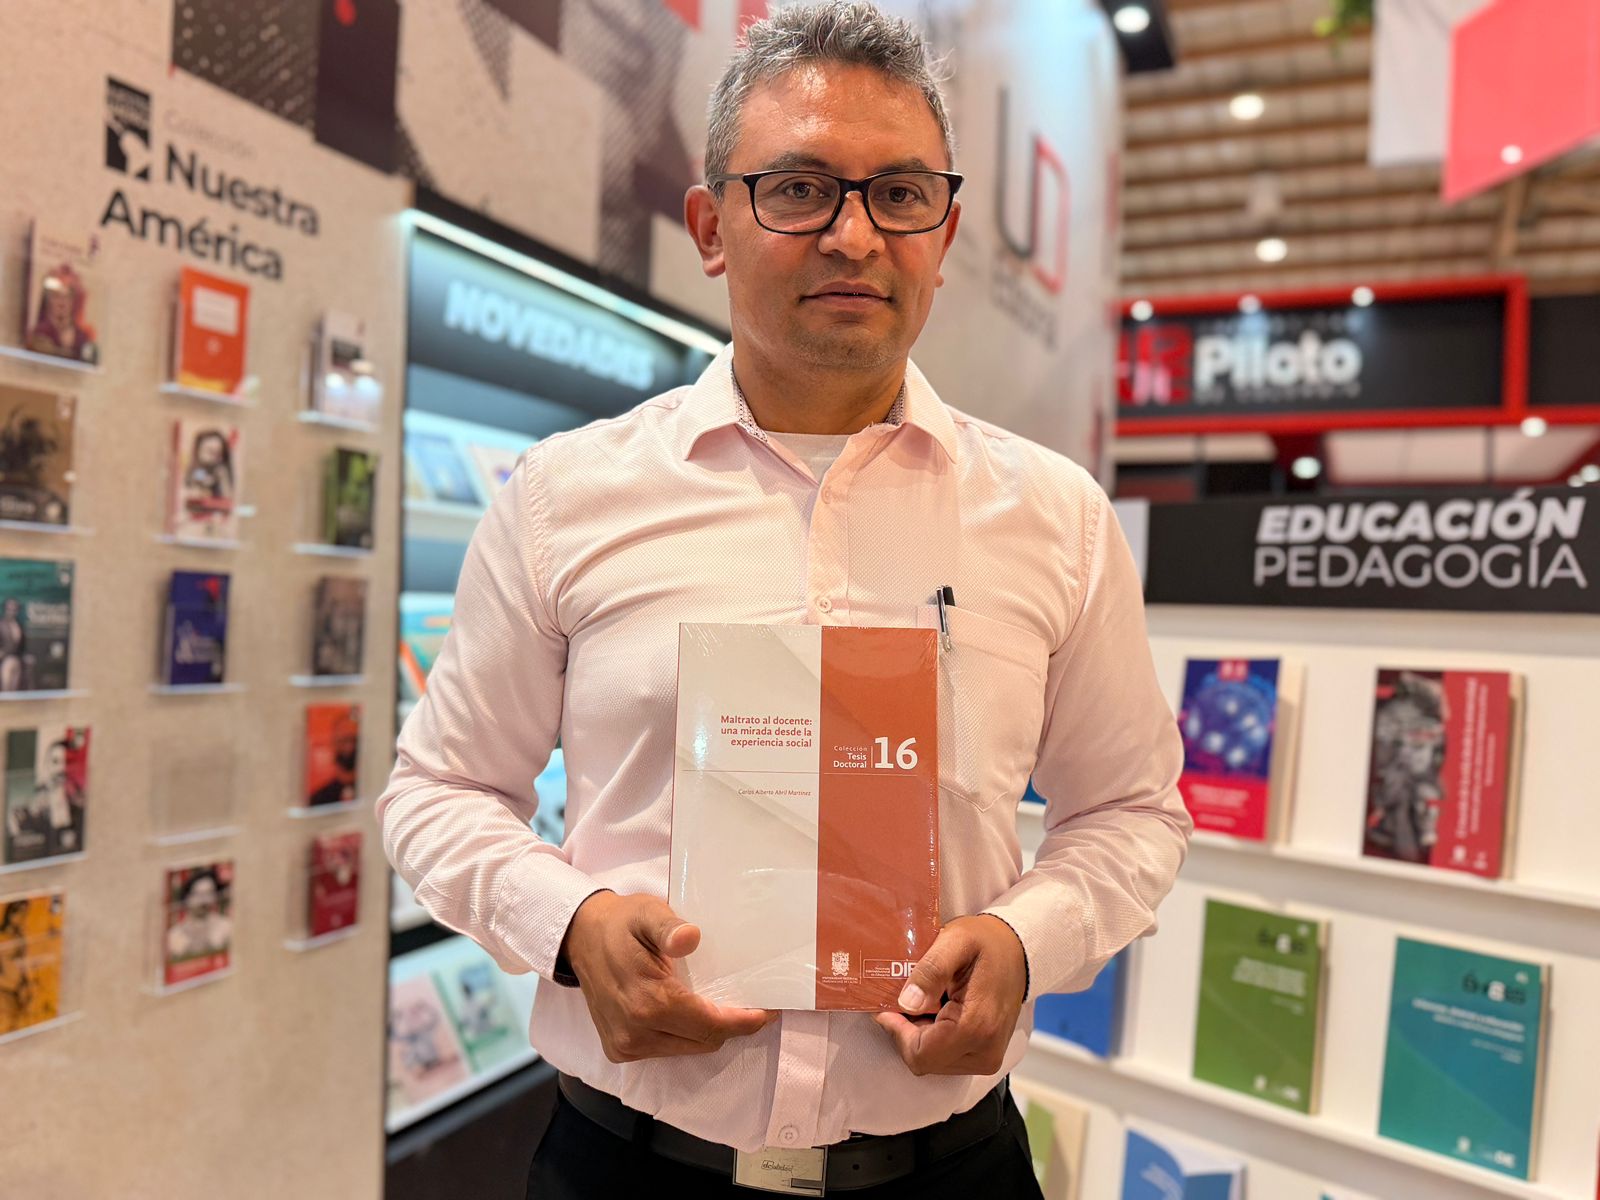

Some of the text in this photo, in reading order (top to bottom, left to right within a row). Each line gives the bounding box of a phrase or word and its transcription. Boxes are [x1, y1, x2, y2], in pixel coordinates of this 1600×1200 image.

[166, 142, 319, 237] Nuestra
[101, 189, 283, 281] América
[445, 280, 654, 391] NOVEDADES
[1194, 331, 1362, 390] Piloto
[1256, 488, 1586, 545] EDUCACIÓN
[1254, 537, 1588, 588] PEDAGOGÍA
[720, 715, 812, 726] Maltrato al docente:
[740, 726, 772, 736] mirada
[774, 727, 802, 736] desde
[803, 728, 812, 737] la
[730, 737, 812, 748] experiencia social
[847, 752, 867, 760] Tesis
[874, 736, 918, 770] 16
[833, 760, 867, 768] Doctoral
